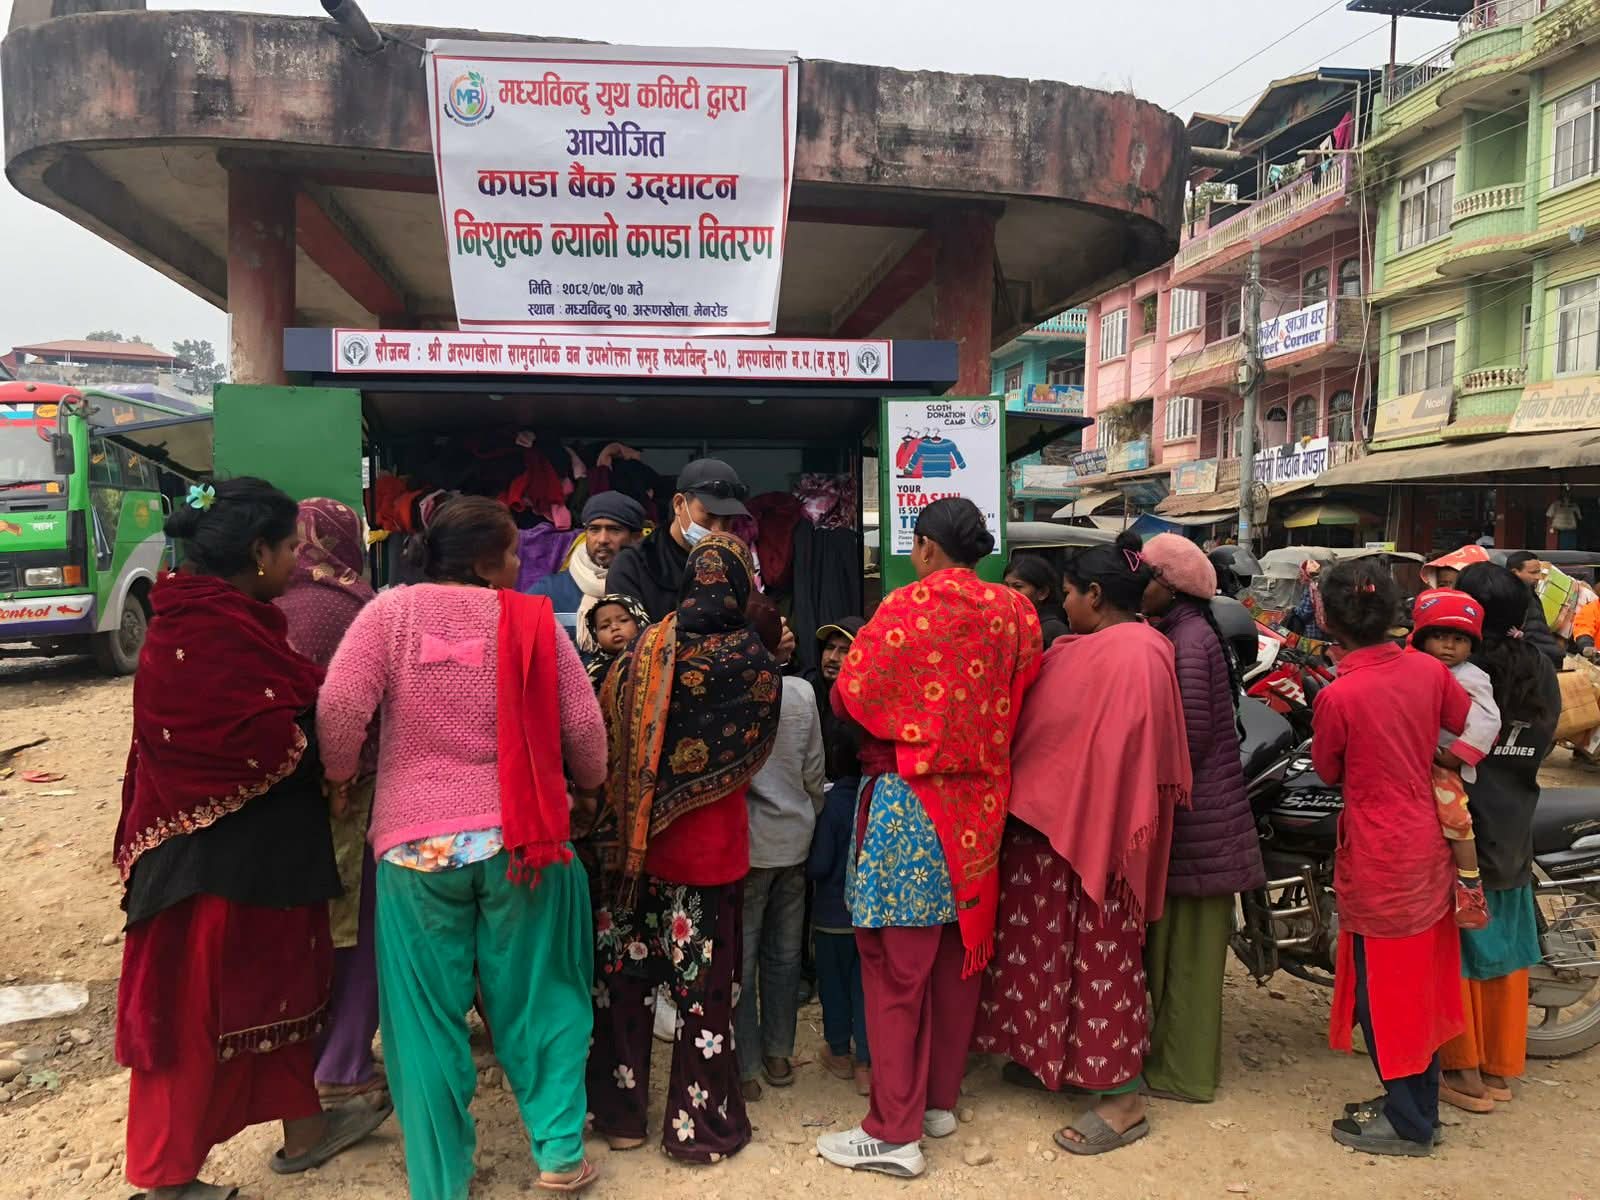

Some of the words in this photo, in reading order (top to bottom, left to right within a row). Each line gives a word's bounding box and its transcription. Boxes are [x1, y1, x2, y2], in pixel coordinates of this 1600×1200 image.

[596, 82, 631, 116] युथ
[637, 74, 701, 110] कमिटी
[566, 121, 666, 158] आयोजित
[477, 170, 559, 197] कपडा
[454, 208, 543, 268] निशुल्क
[551, 212, 619, 257] न्यानो
[626, 225, 691, 259] कपडा
[698, 212, 775, 261] वितरण
[529, 279, 552, 296] मिति
[627, 280, 644, 297] गते
[528, 303, 555, 316] स्थान
[1283, 330, 1320, 349] Corner
[428, 336, 442, 362] श्री
[508, 338, 561, 371] सामुदायिक
[927, 411, 966, 419] DONATION
[897, 485, 921, 493] YOUR
[1493, 745, 1536, 757] BODIES
